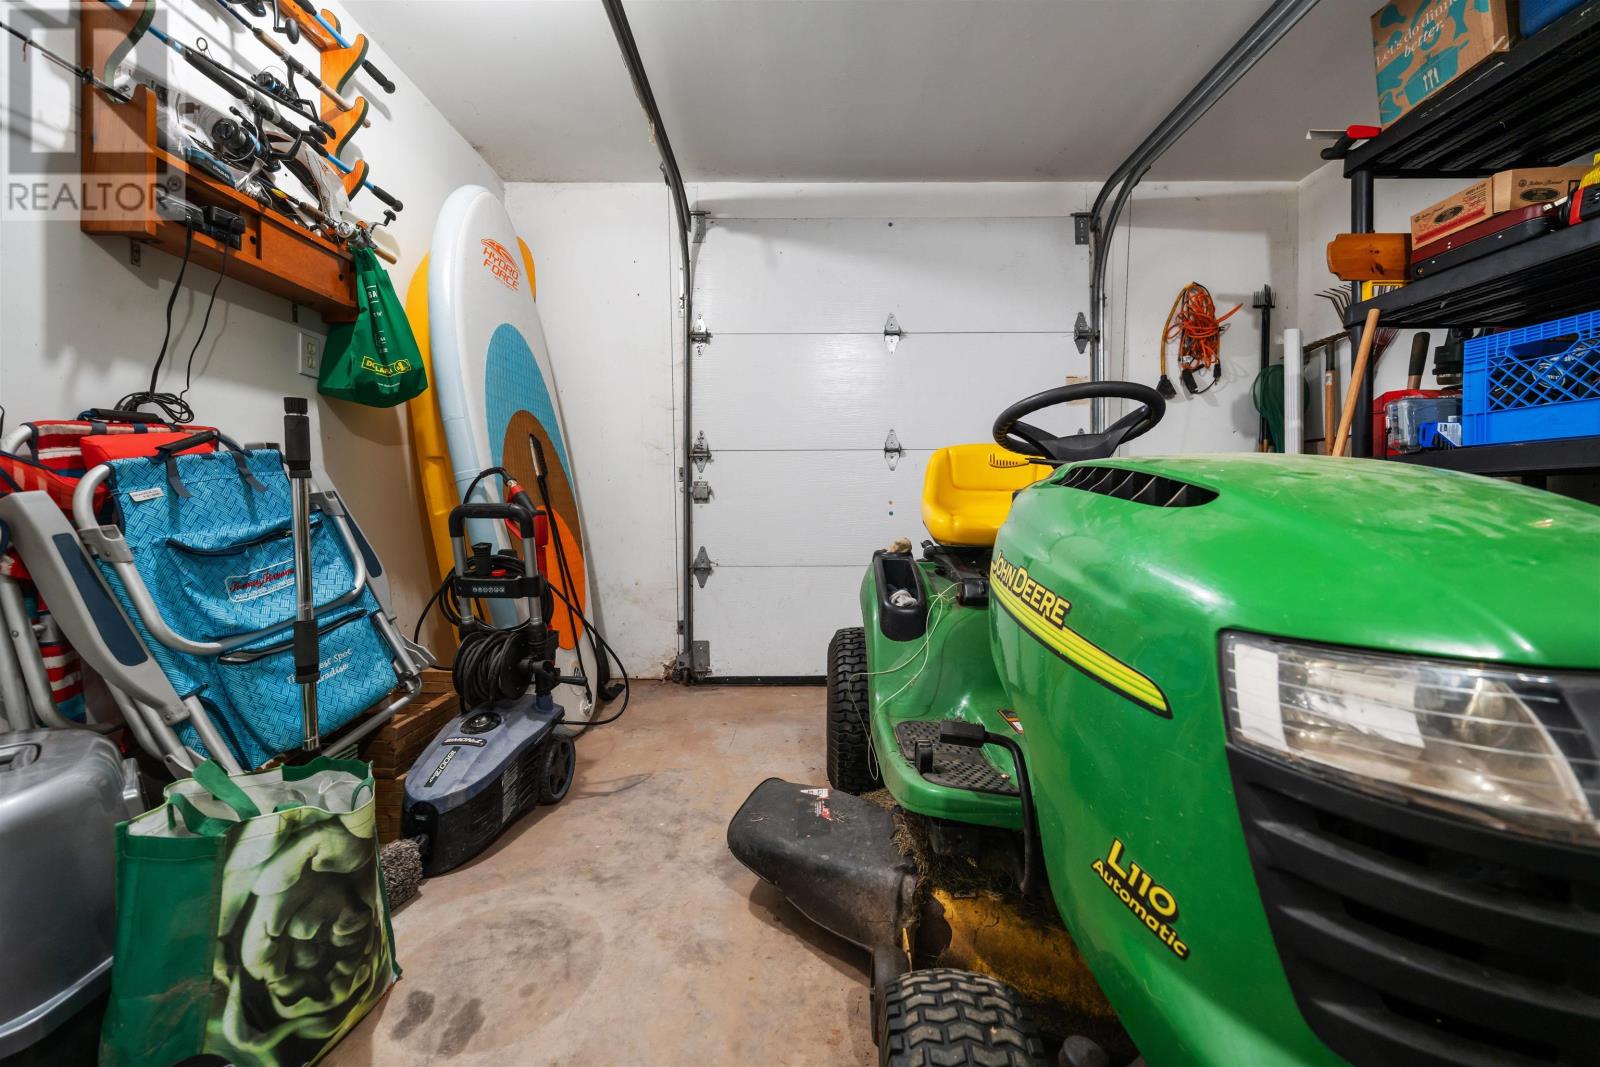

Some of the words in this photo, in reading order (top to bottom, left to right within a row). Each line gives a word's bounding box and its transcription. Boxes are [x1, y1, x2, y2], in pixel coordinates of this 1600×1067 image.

[482, 246, 519, 280] HYDRO
[483, 258, 520, 291] FORCE
[992, 551, 1017, 589] JOHN
[1011, 567, 1071, 626] DEERE
[1092, 860, 1188, 957] Automatic
[1106, 839, 1178, 917] L110
